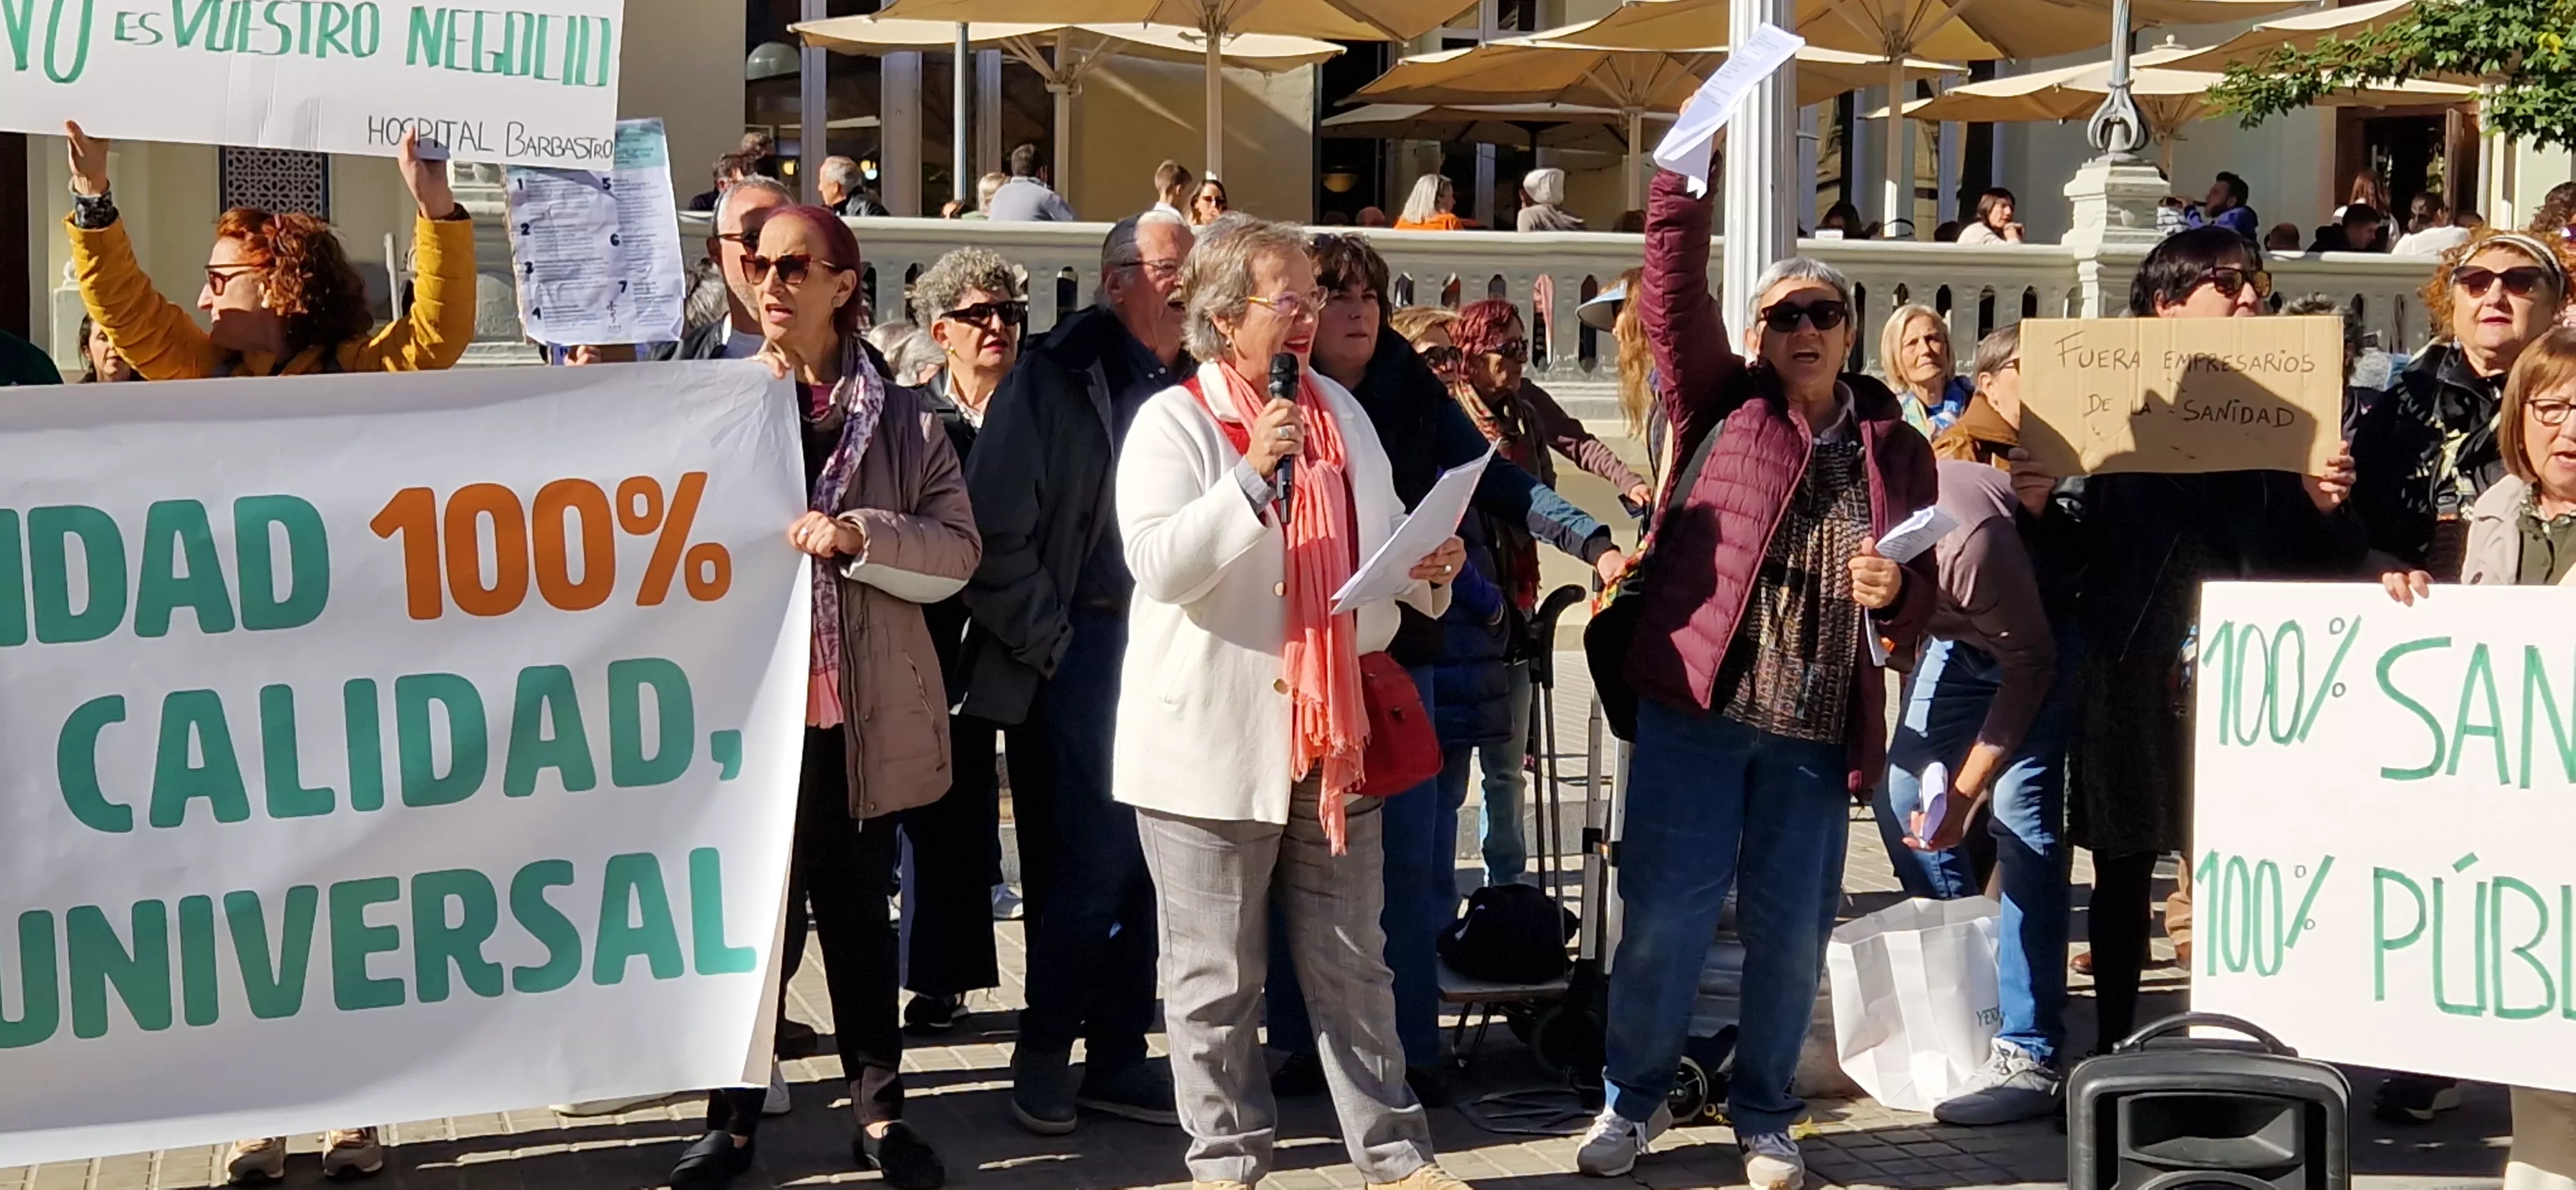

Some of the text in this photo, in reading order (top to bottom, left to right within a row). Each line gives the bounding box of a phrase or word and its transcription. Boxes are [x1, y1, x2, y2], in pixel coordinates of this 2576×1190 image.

[114, 12, 163, 45] ES
[171, 0, 380, 59] VUESTRO
[406, 6, 612, 87] NEGOCIO
[601, 177, 611, 190] 5
[520, 223, 530, 236] 2
[610, 233, 620, 247] 6
[618, 280, 627, 294] 7
[2054, 330, 2141, 370] FUERA
[2083, 393, 2112, 417] DE
[2130, 400, 2152, 416] LA
[369, 471, 732, 620] 100%
[2202, 614, 2576, 789] 100% SAN
[57, 657, 743, 833] CALIDAD,
[2195, 849, 2336, 977] 100%
[0, 847, 757, 1049] UNIVERSAL
